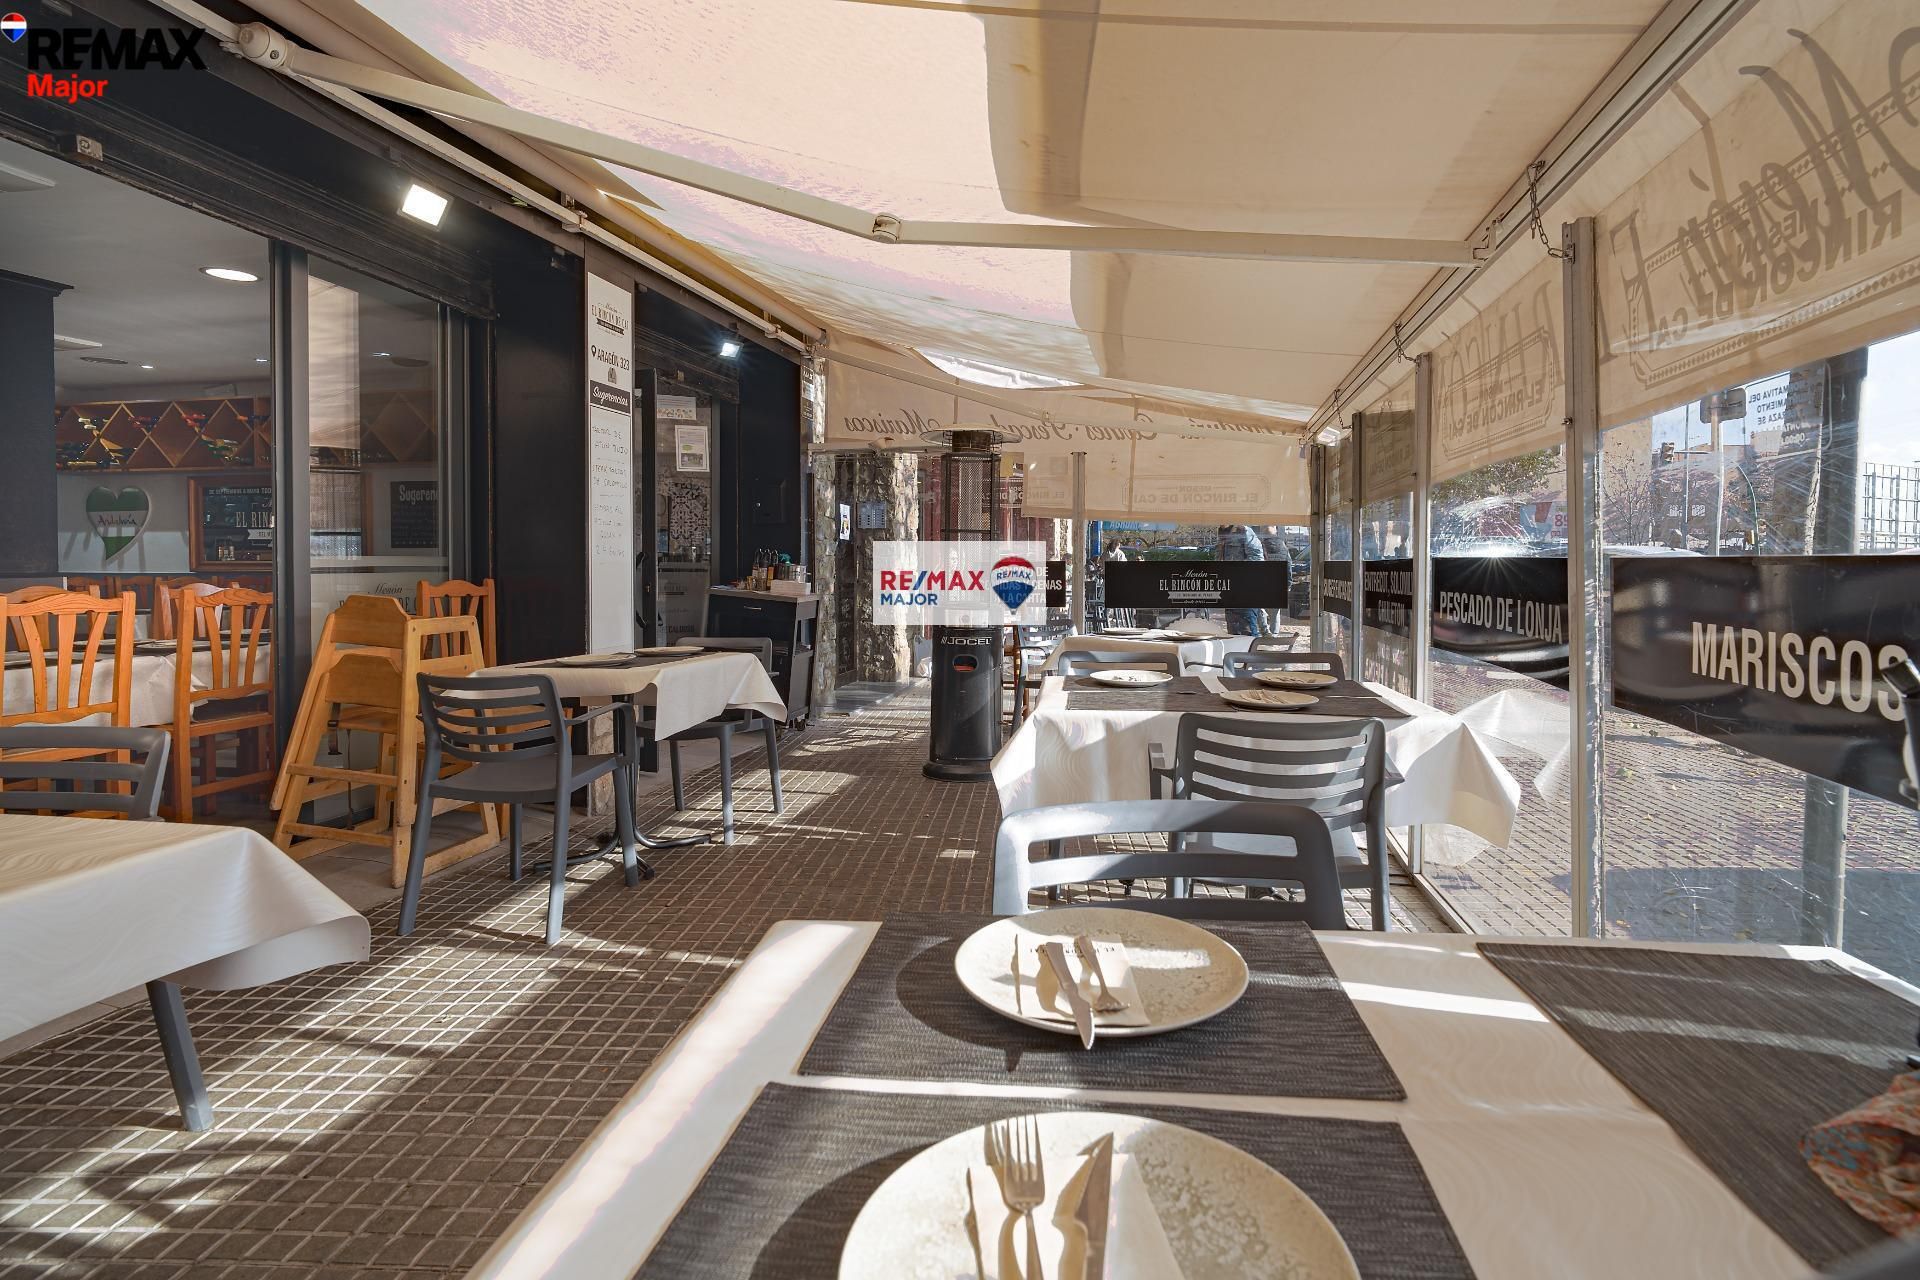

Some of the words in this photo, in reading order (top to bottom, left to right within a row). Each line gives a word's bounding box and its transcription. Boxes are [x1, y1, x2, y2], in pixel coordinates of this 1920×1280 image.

[597, 347, 619, 367] ARAGÓN
[620, 356, 630, 371] 323
[592, 386, 628, 406] Sugerencias
[1159, 579, 1169, 591] EL
[1204, 579, 1215, 591] DE
[1439, 591, 1492, 629] PESCADO
[1496, 597, 1513, 633] DE
[1516, 599, 1563, 645] LONJA
[947, 636, 992, 646] JOCEL
[1692, 621, 1909, 722] MARISCOS
